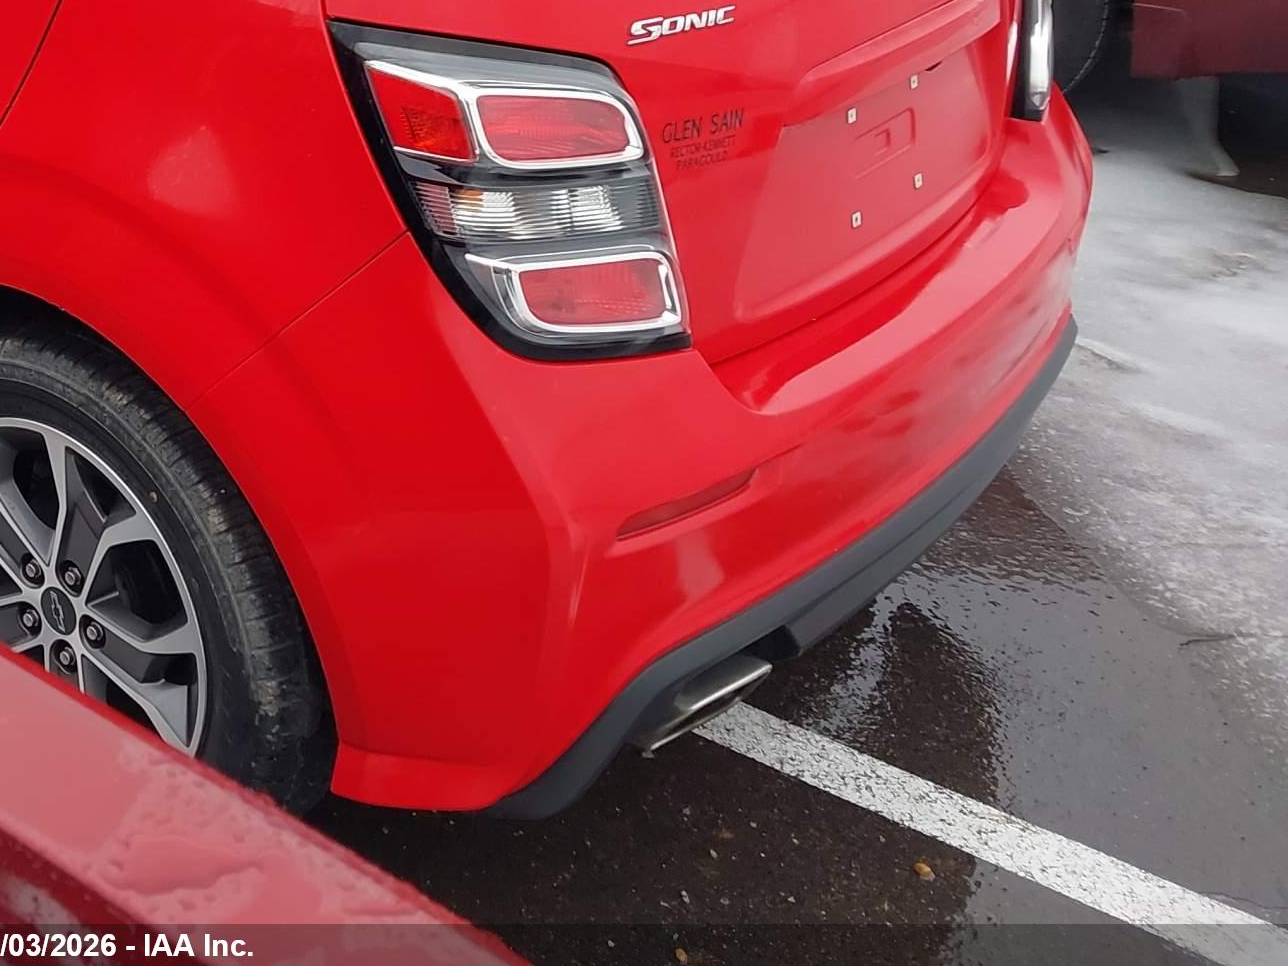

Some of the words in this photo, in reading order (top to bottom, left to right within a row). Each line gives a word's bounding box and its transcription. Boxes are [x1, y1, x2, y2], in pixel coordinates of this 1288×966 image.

[627, 5, 736, 45] SONIC
[662, 116, 703, 144] GLEN
[710, 107, 744, 134] SAIN
